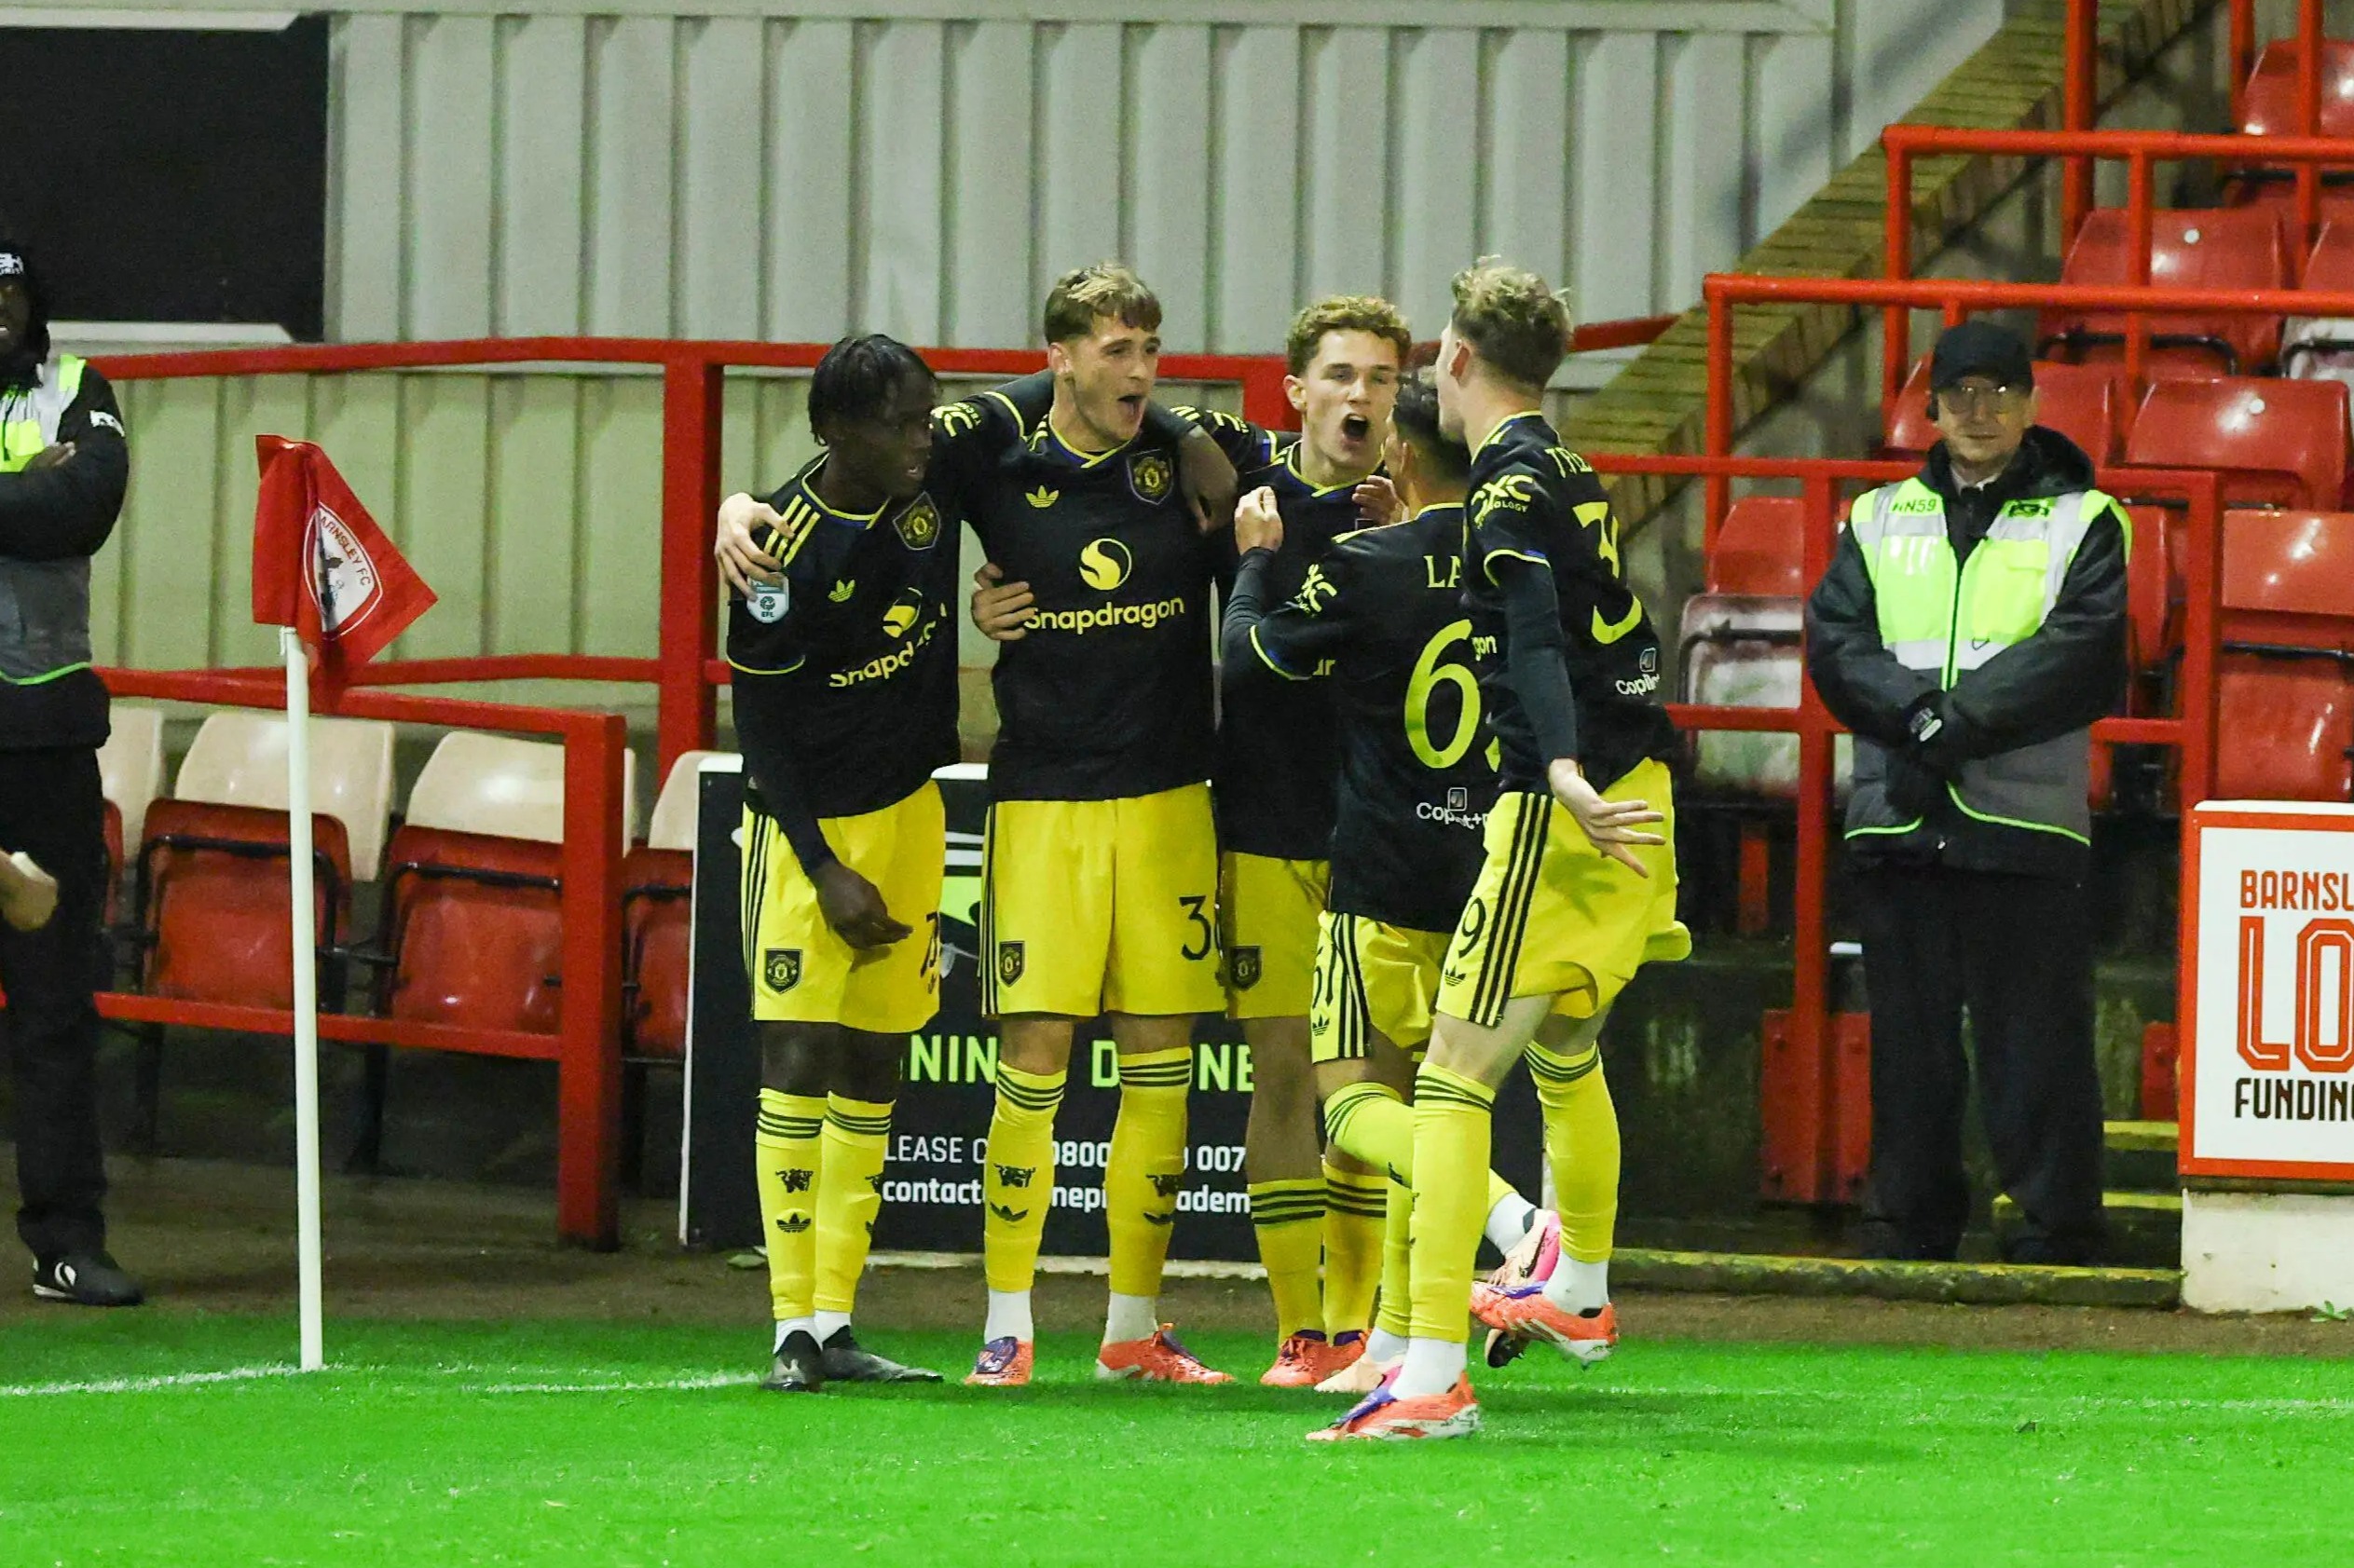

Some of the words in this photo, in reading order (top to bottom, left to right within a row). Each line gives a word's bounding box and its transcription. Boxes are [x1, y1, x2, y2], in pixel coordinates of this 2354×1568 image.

[321, 516, 363, 565] ARNSLEY
[356, 567, 371, 586] FC
[1423, 555, 1462, 588] LA
[1404, 619, 1501, 773] 6
[2239, 869, 2354, 911] BARNSL
[1178, 894, 1221, 961] 3
[2237, 916, 2354, 1073] LO
[2235, 1077, 2354, 1122] FUNDIN
[884, 1135, 965, 1164] LEASE
